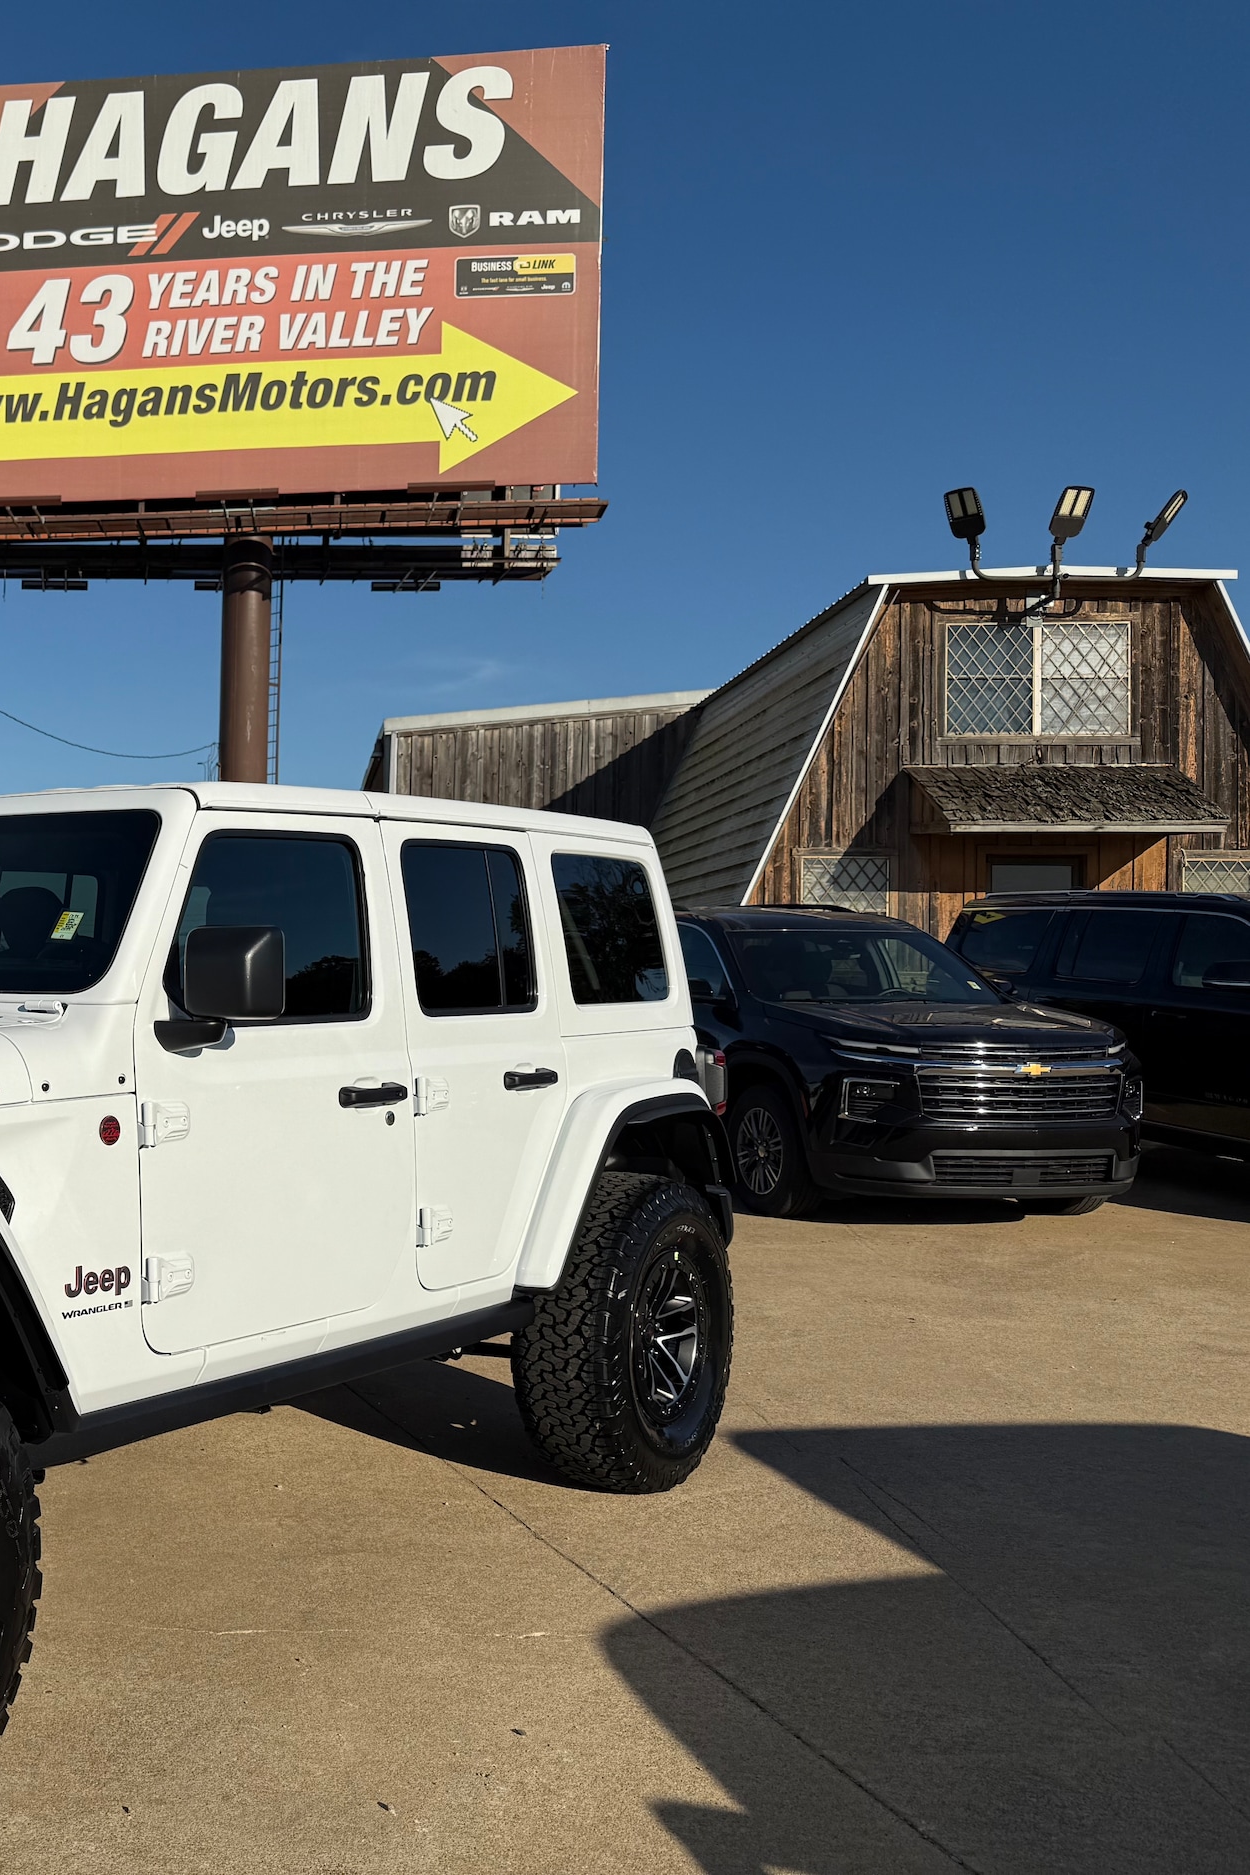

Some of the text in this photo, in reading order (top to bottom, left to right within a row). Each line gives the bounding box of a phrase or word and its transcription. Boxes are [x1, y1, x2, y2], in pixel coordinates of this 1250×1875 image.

[202, 215, 270, 241] Jeep
[301, 208, 413, 222] CHRYSLER
[489, 208, 581, 227] RAM
[470, 259, 557, 272] BUSINESS LINK
[147, 259, 429, 310] YEARS IN THE
[5, 274, 136, 366] 43
[141, 306, 434, 359] RIVER VALLEY
[64, 1265, 131, 1298] Jeep
[61, 1302, 122, 1320] WRANGLER
